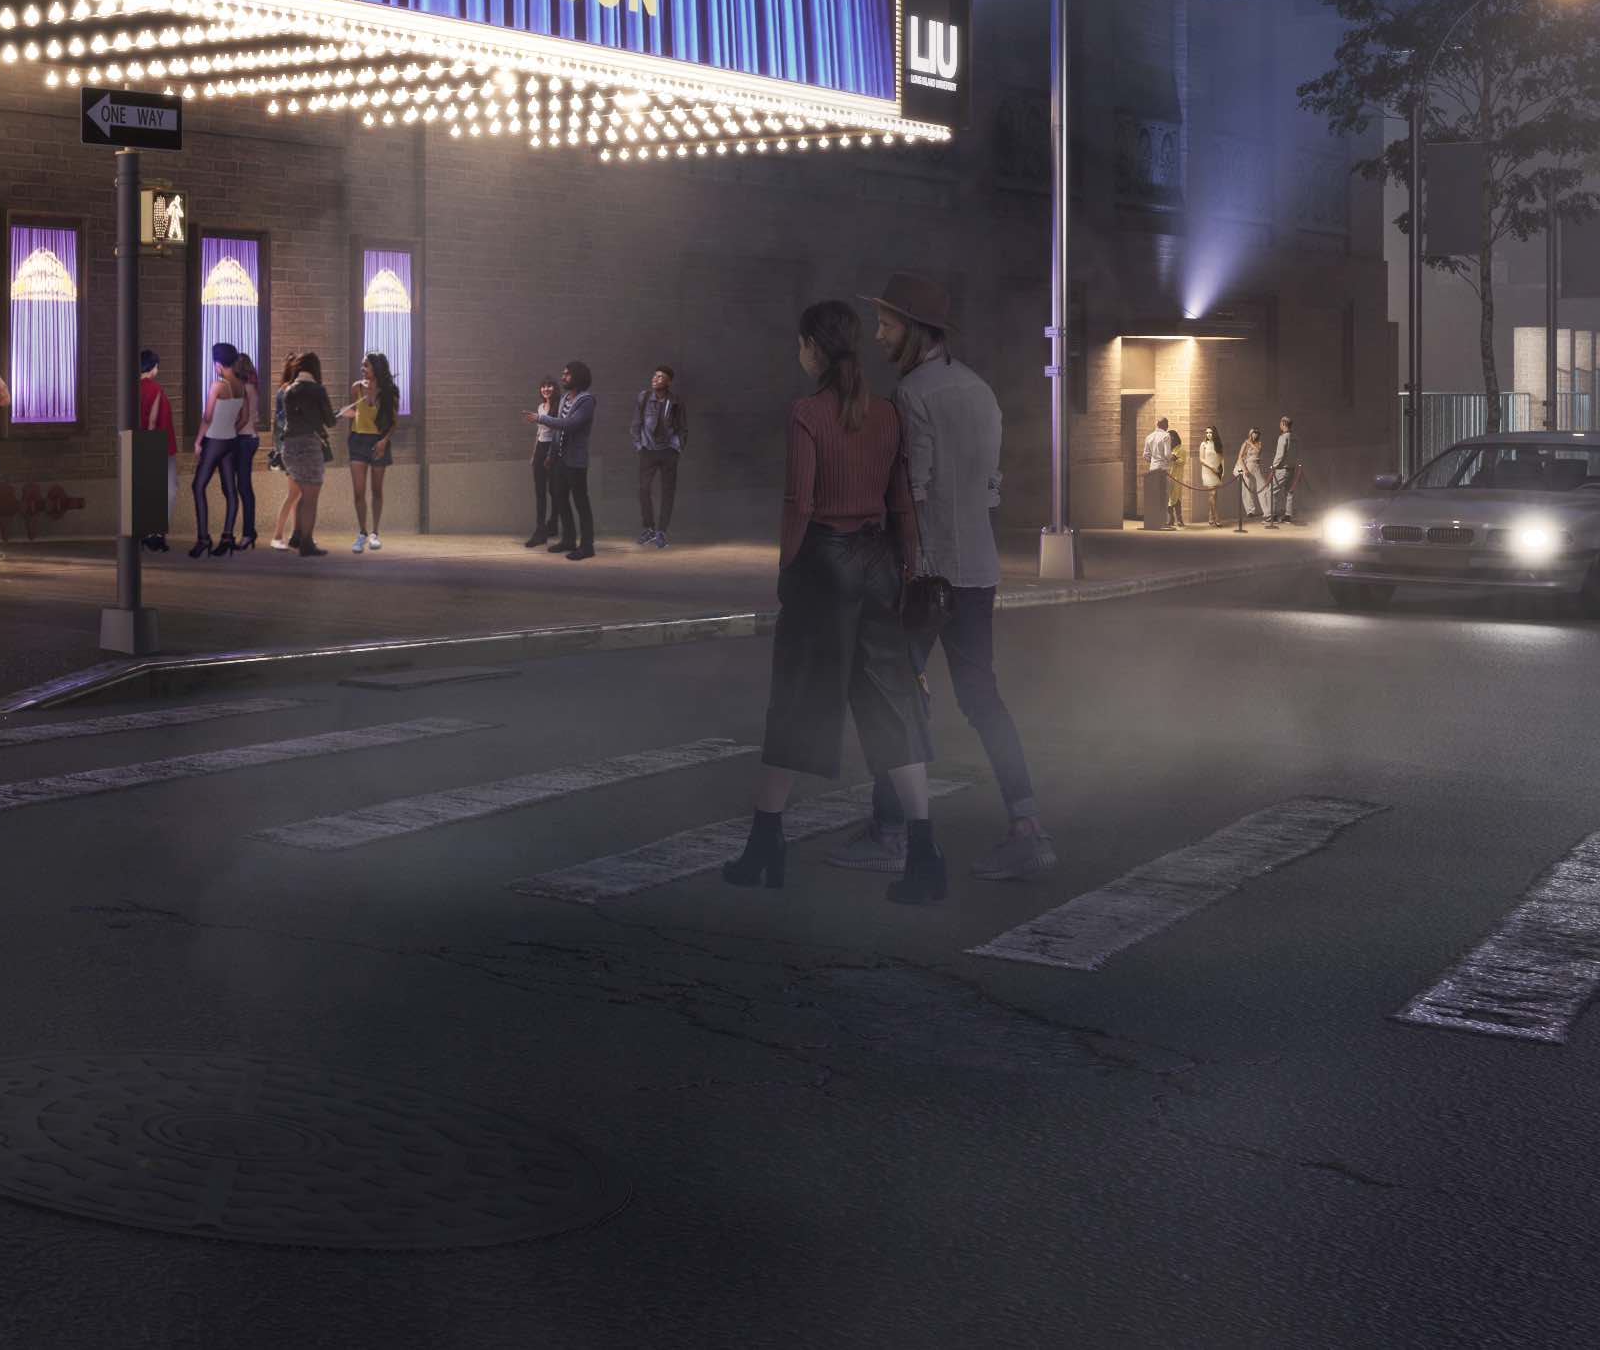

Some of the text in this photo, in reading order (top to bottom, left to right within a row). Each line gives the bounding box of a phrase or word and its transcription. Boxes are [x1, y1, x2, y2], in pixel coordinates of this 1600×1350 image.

[911, 15, 958, 79] LIU
[101, 105, 164, 126] ONE WAY
